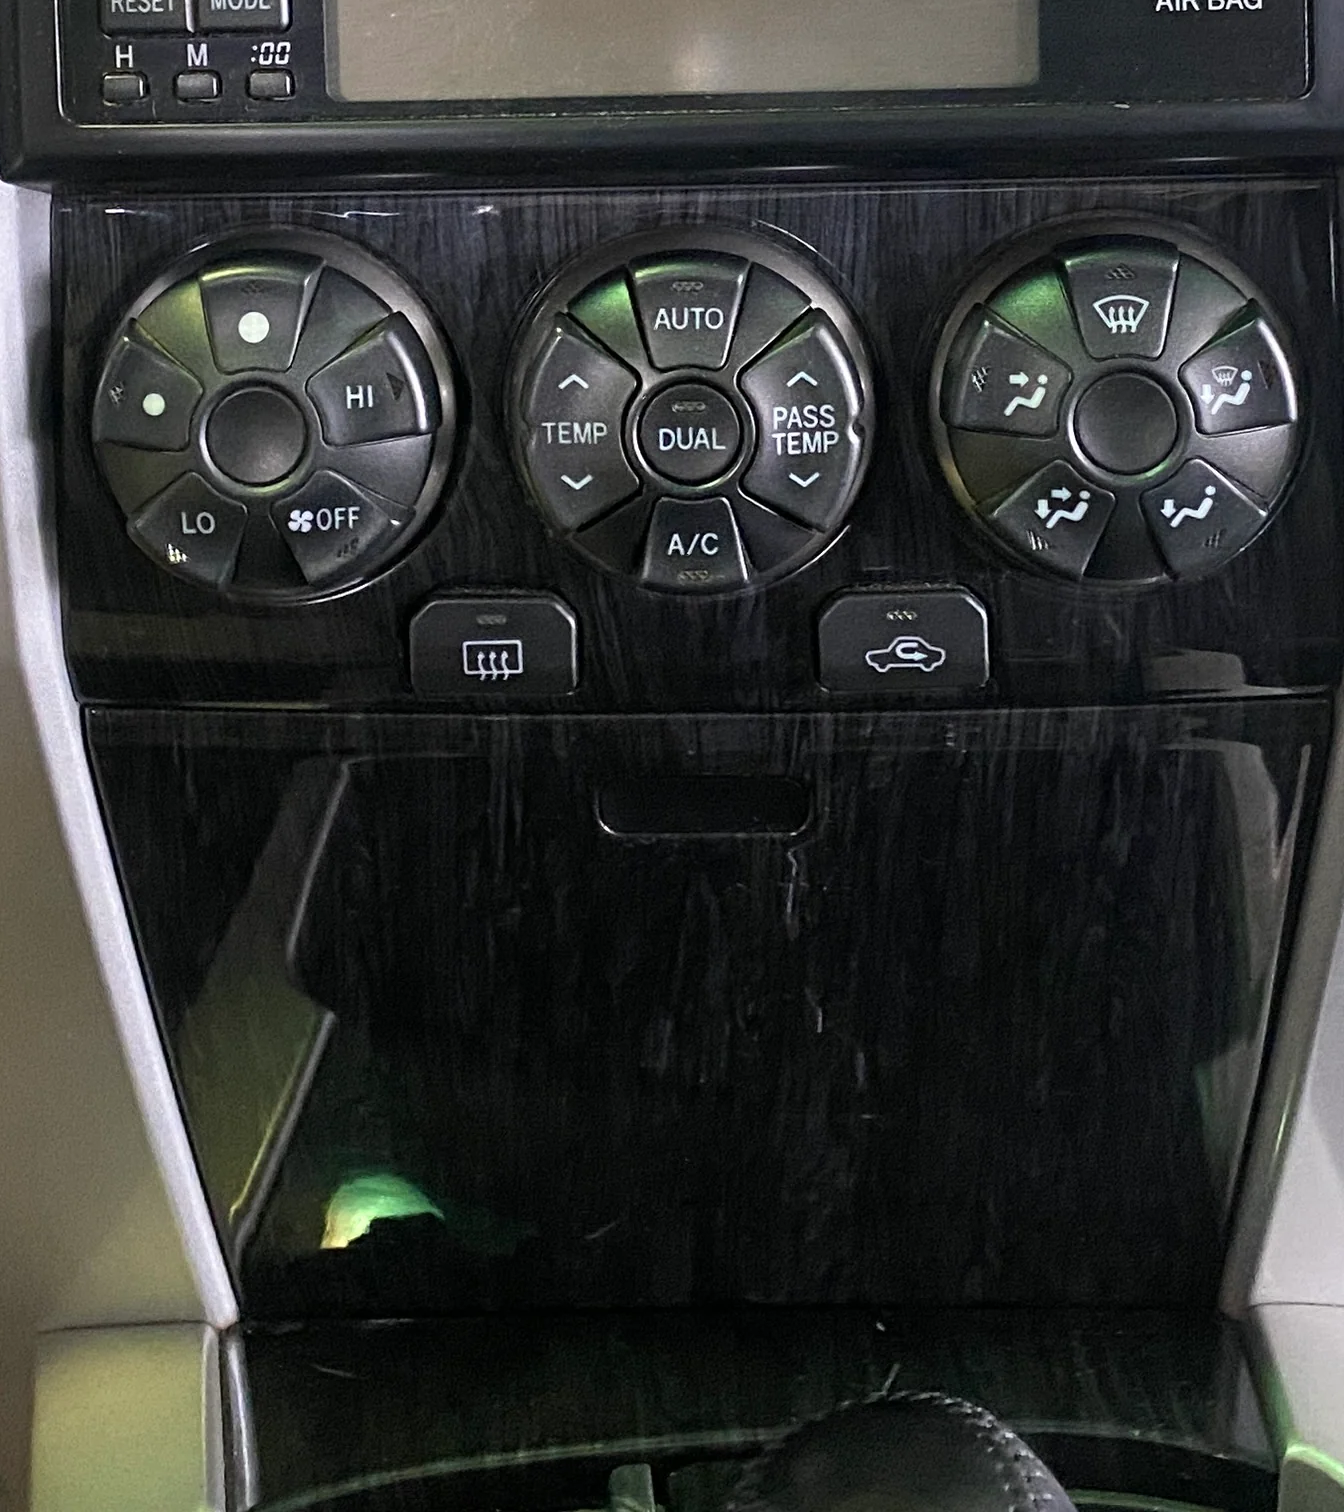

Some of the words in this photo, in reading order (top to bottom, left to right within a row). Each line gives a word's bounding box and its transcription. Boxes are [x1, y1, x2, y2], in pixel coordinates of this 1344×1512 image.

[115, 45, 133, 68] H
[187, 44, 208, 67] M
[653, 307, 724, 330] AUTO
[346, 385, 373, 410] HI
[772, 404, 835, 429] PASS
[541, 422, 607, 445] TEMP
[658, 427, 726, 451] DUAL
[771, 431, 839, 455] TEMP
[180, 511, 216, 535] LO
[316, 507, 360, 531] OFF
[667, 533, 719, 556] A/C
